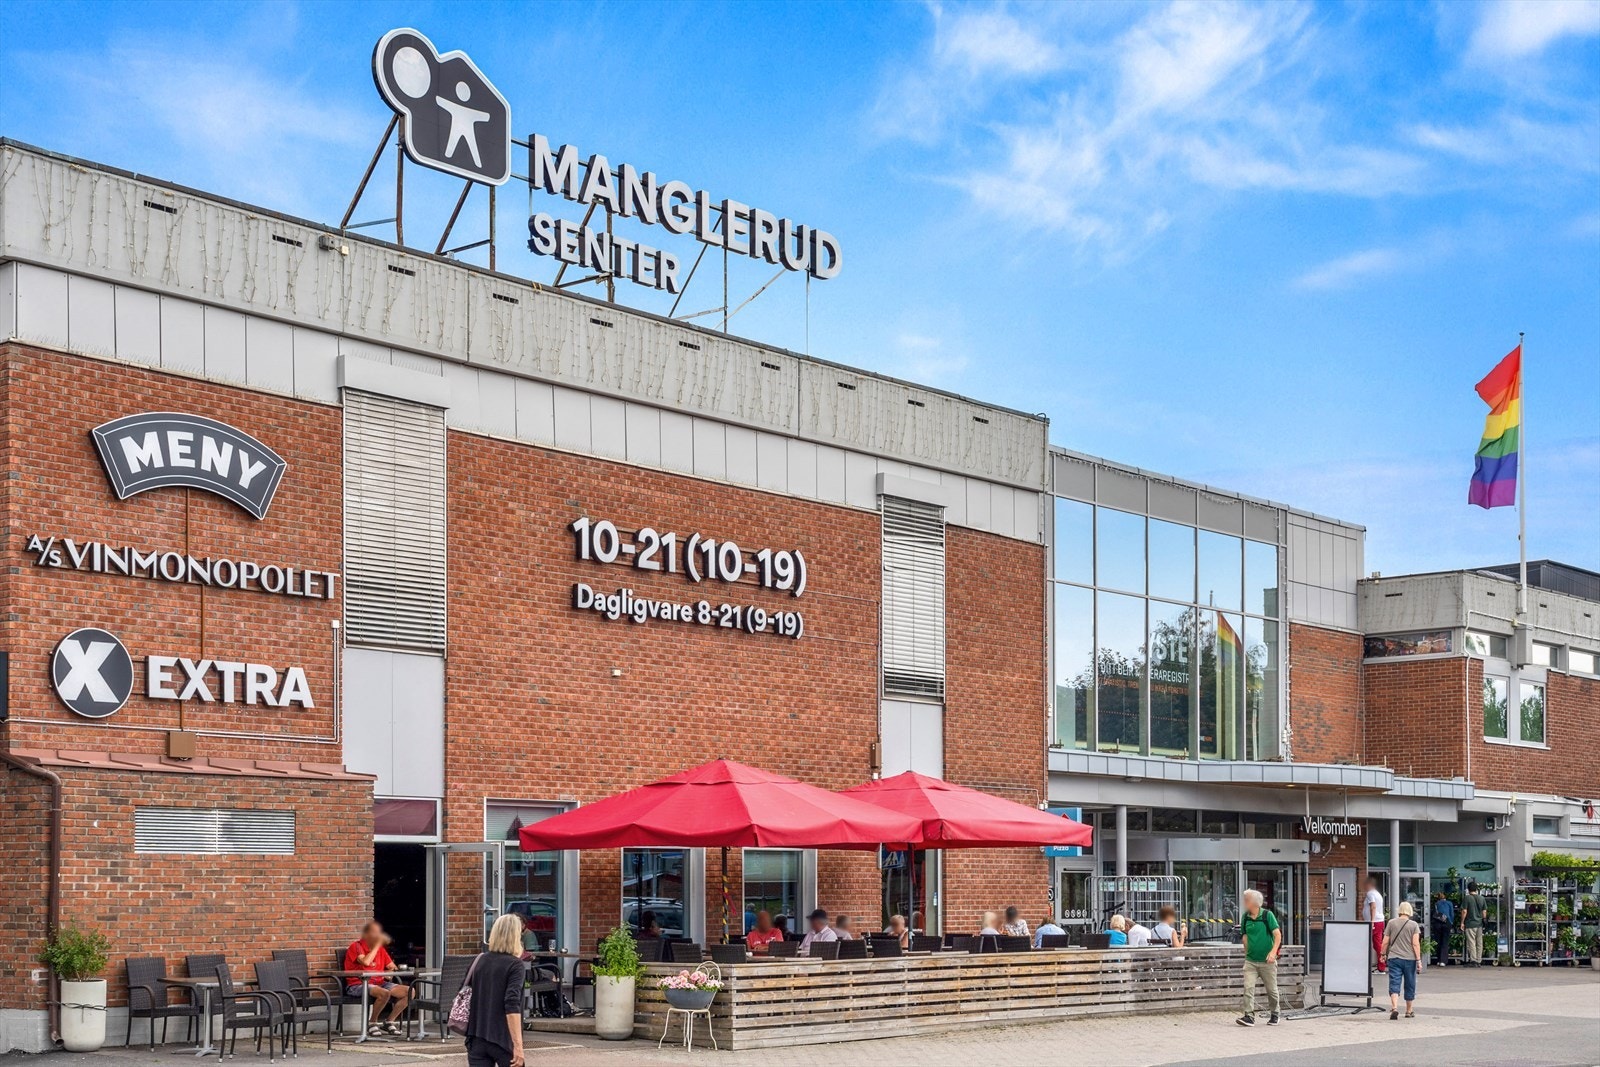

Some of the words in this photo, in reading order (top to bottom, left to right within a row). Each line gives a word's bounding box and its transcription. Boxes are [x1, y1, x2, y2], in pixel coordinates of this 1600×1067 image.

[529, 133, 842, 279] MANGLERUD
[529, 213, 680, 294] SENTER
[119, 430, 267, 489] MENY
[27, 533, 62, 567] A/S
[63, 538, 340, 599] VINMONOPOLET
[571, 516, 677, 573] 10-21
[684, 532, 807, 598] (10-19)
[575, 583, 693, 624] Dagligvare
[697, 600, 742, 629] 8-21
[745, 605, 804, 640] (9-19)
[58, 639, 120, 704] X
[147, 655, 315, 709] EXTRA
[1303, 816, 1362, 836] Velkommen
